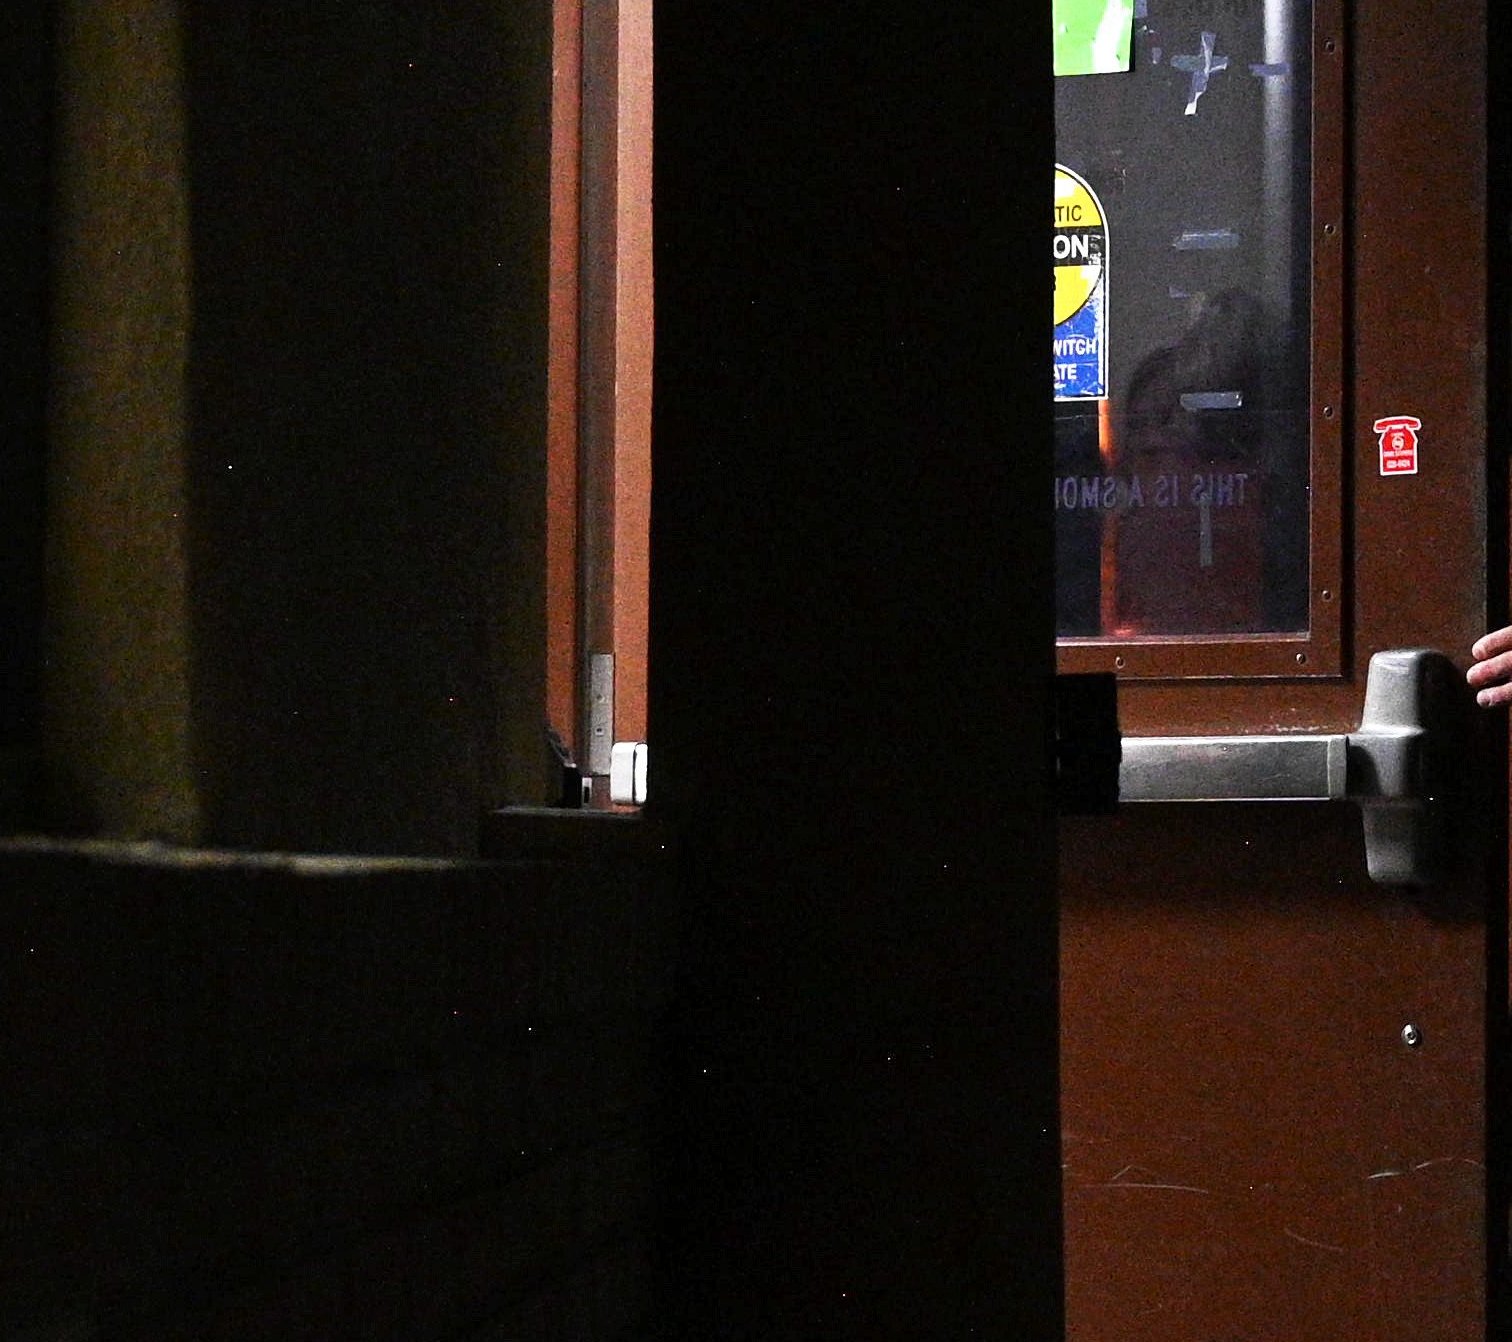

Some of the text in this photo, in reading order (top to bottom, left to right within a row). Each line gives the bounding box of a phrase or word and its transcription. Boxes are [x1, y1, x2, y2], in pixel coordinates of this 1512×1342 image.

[1055, 205, 1082, 222] TIC
[1053, 234, 1089, 259] ON
[1053, 339, 1097, 355] WITCH
